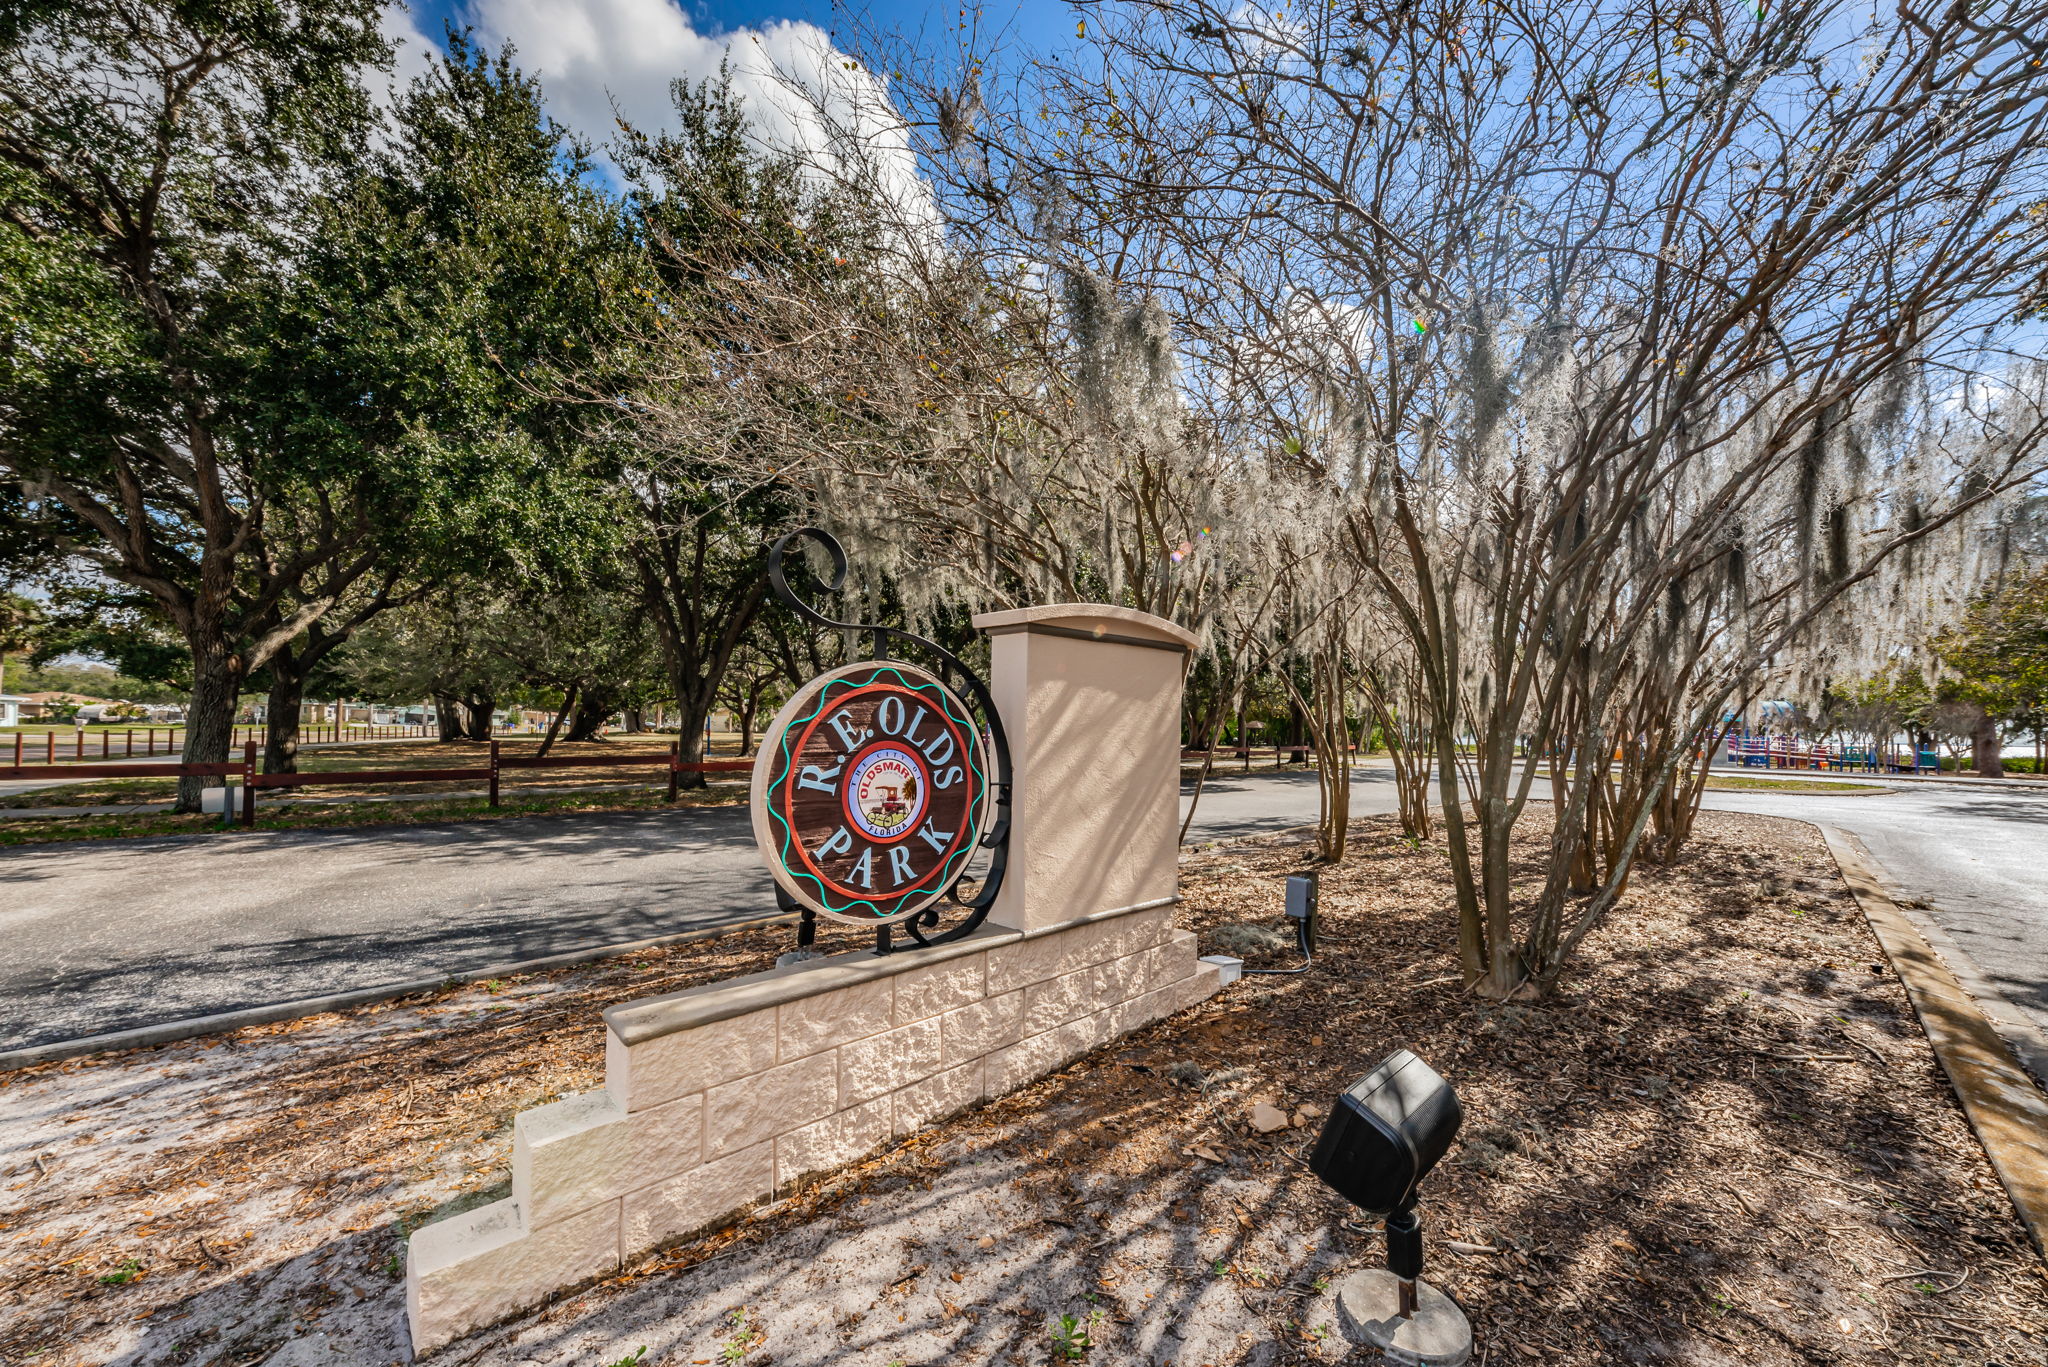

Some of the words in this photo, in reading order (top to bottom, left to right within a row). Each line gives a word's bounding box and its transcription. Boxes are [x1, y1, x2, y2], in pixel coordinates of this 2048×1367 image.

[798, 710, 874, 796] R.E.
[879, 696, 963, 789] OLDS
[877, 752, 905, 760] CITY
[861, 762, 909, 799] OLDSMAR
[869, 823, 907, 835] FLORIDA
[812, 816, 954, 889] PARK
